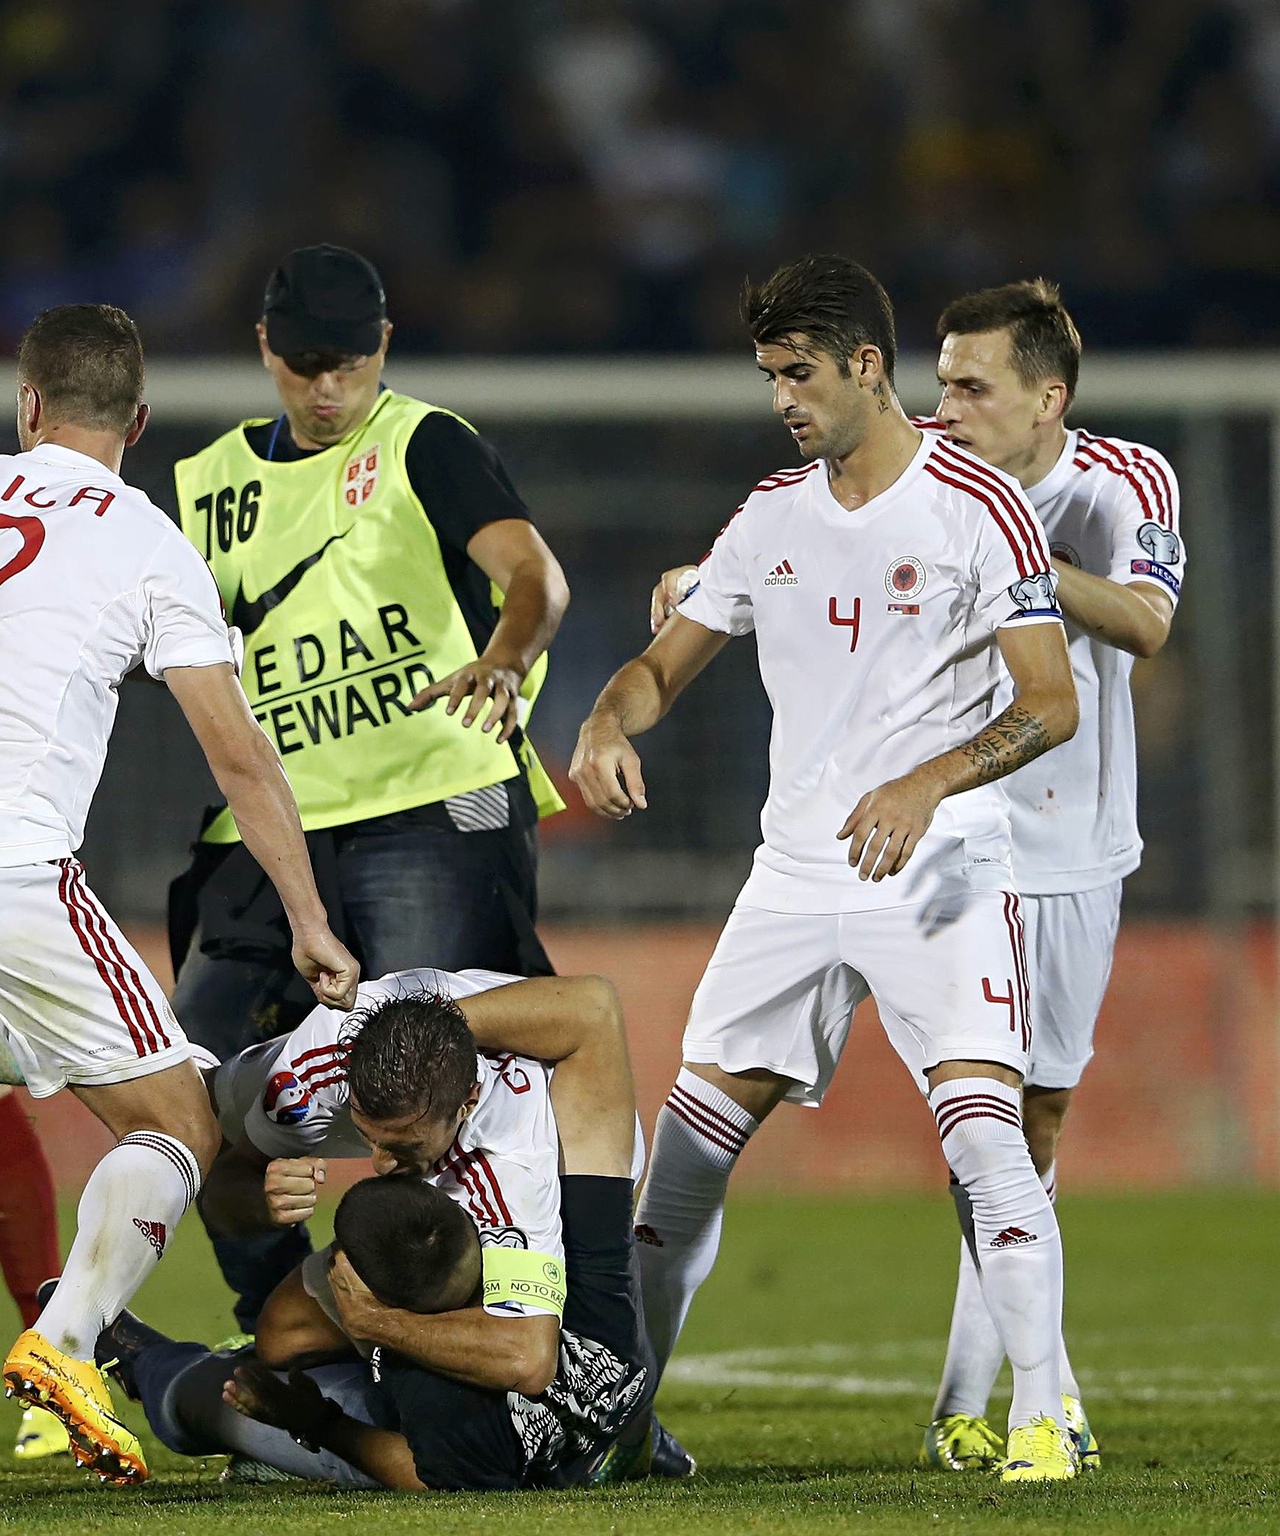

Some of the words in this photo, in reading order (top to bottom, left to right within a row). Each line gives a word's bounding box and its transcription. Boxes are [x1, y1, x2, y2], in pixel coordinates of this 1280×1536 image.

[195, 480, 262, 562] 766
[764, 574, 799, 586] adidas
[829, 596, 861, 653] 4
[981, 977, 1015, 1032] 4
[132, 1217, 163, 1261] adidas
[510, 1282, 531, 1293] NO
[533, 1284, 549, 1296] TO
